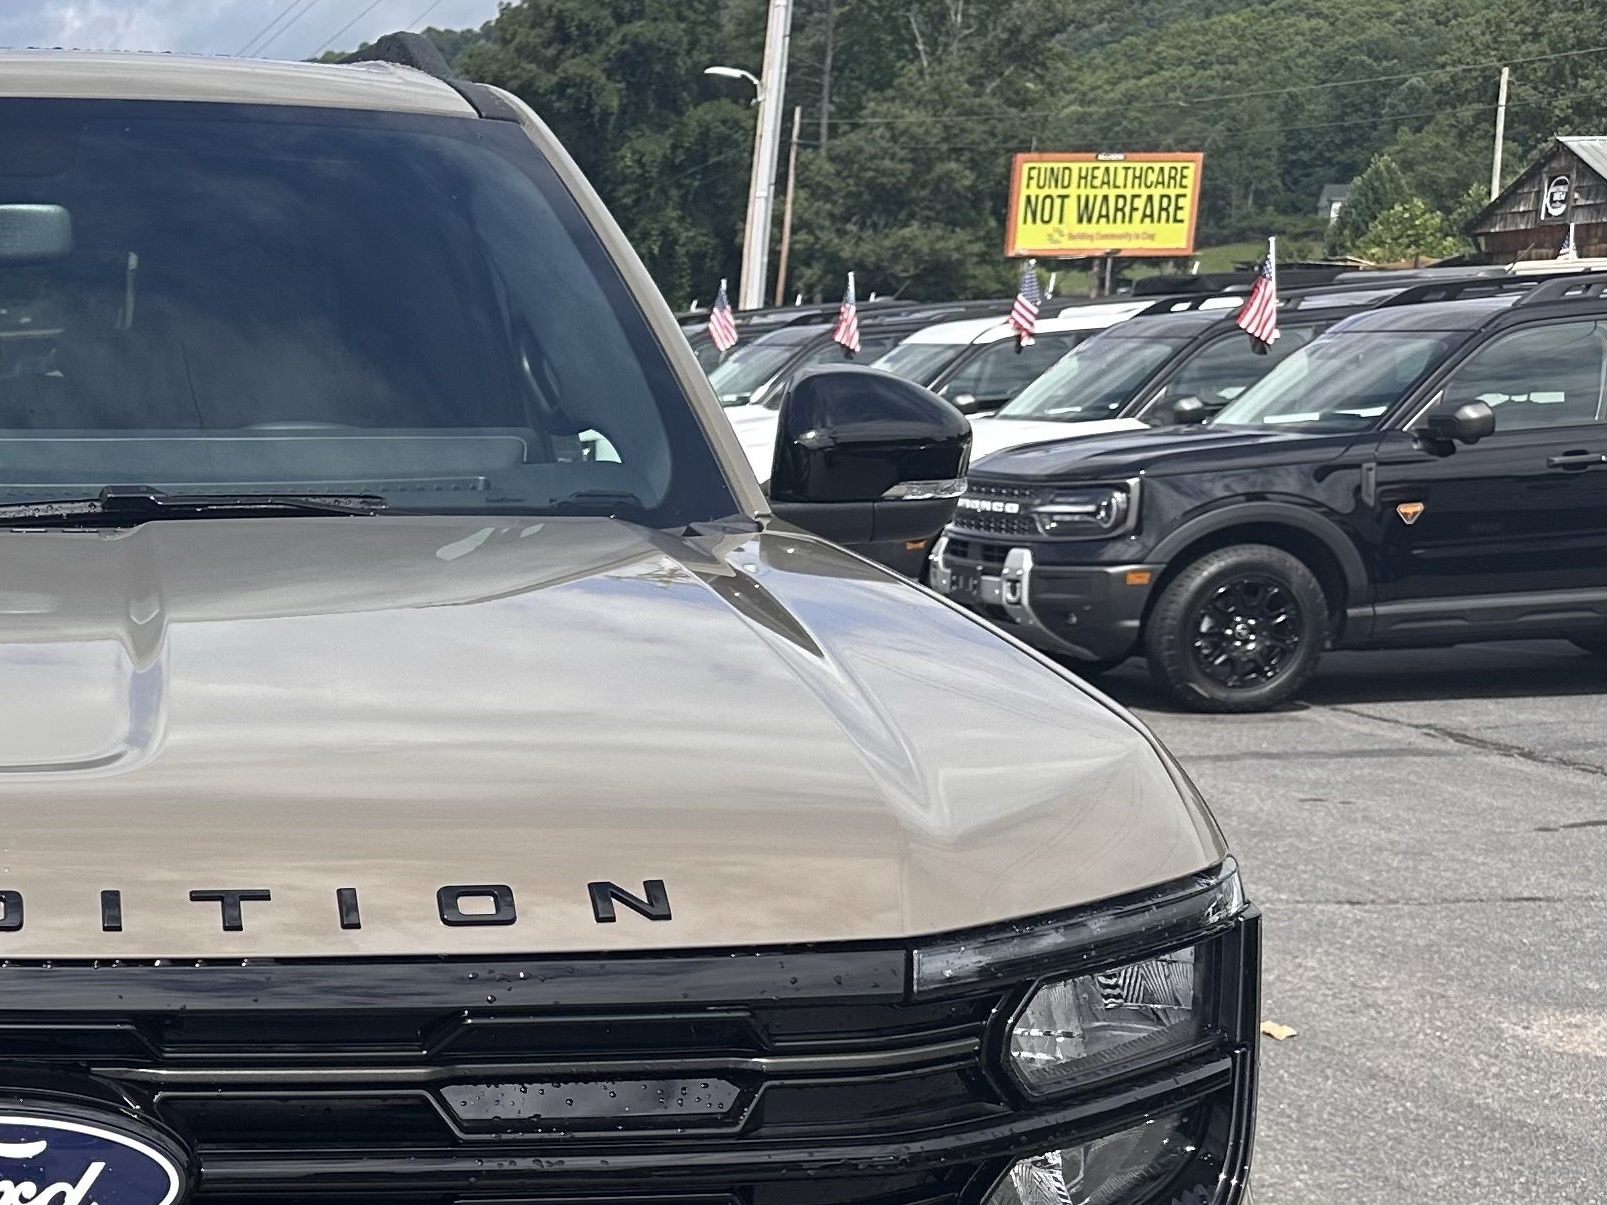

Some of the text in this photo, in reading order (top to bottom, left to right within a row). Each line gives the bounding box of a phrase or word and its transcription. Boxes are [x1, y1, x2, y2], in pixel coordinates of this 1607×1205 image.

[1025, 165, 1190, 190] FUND HEALTHCARE
[1023, 194, 1187, 225] NOT WARFARE
